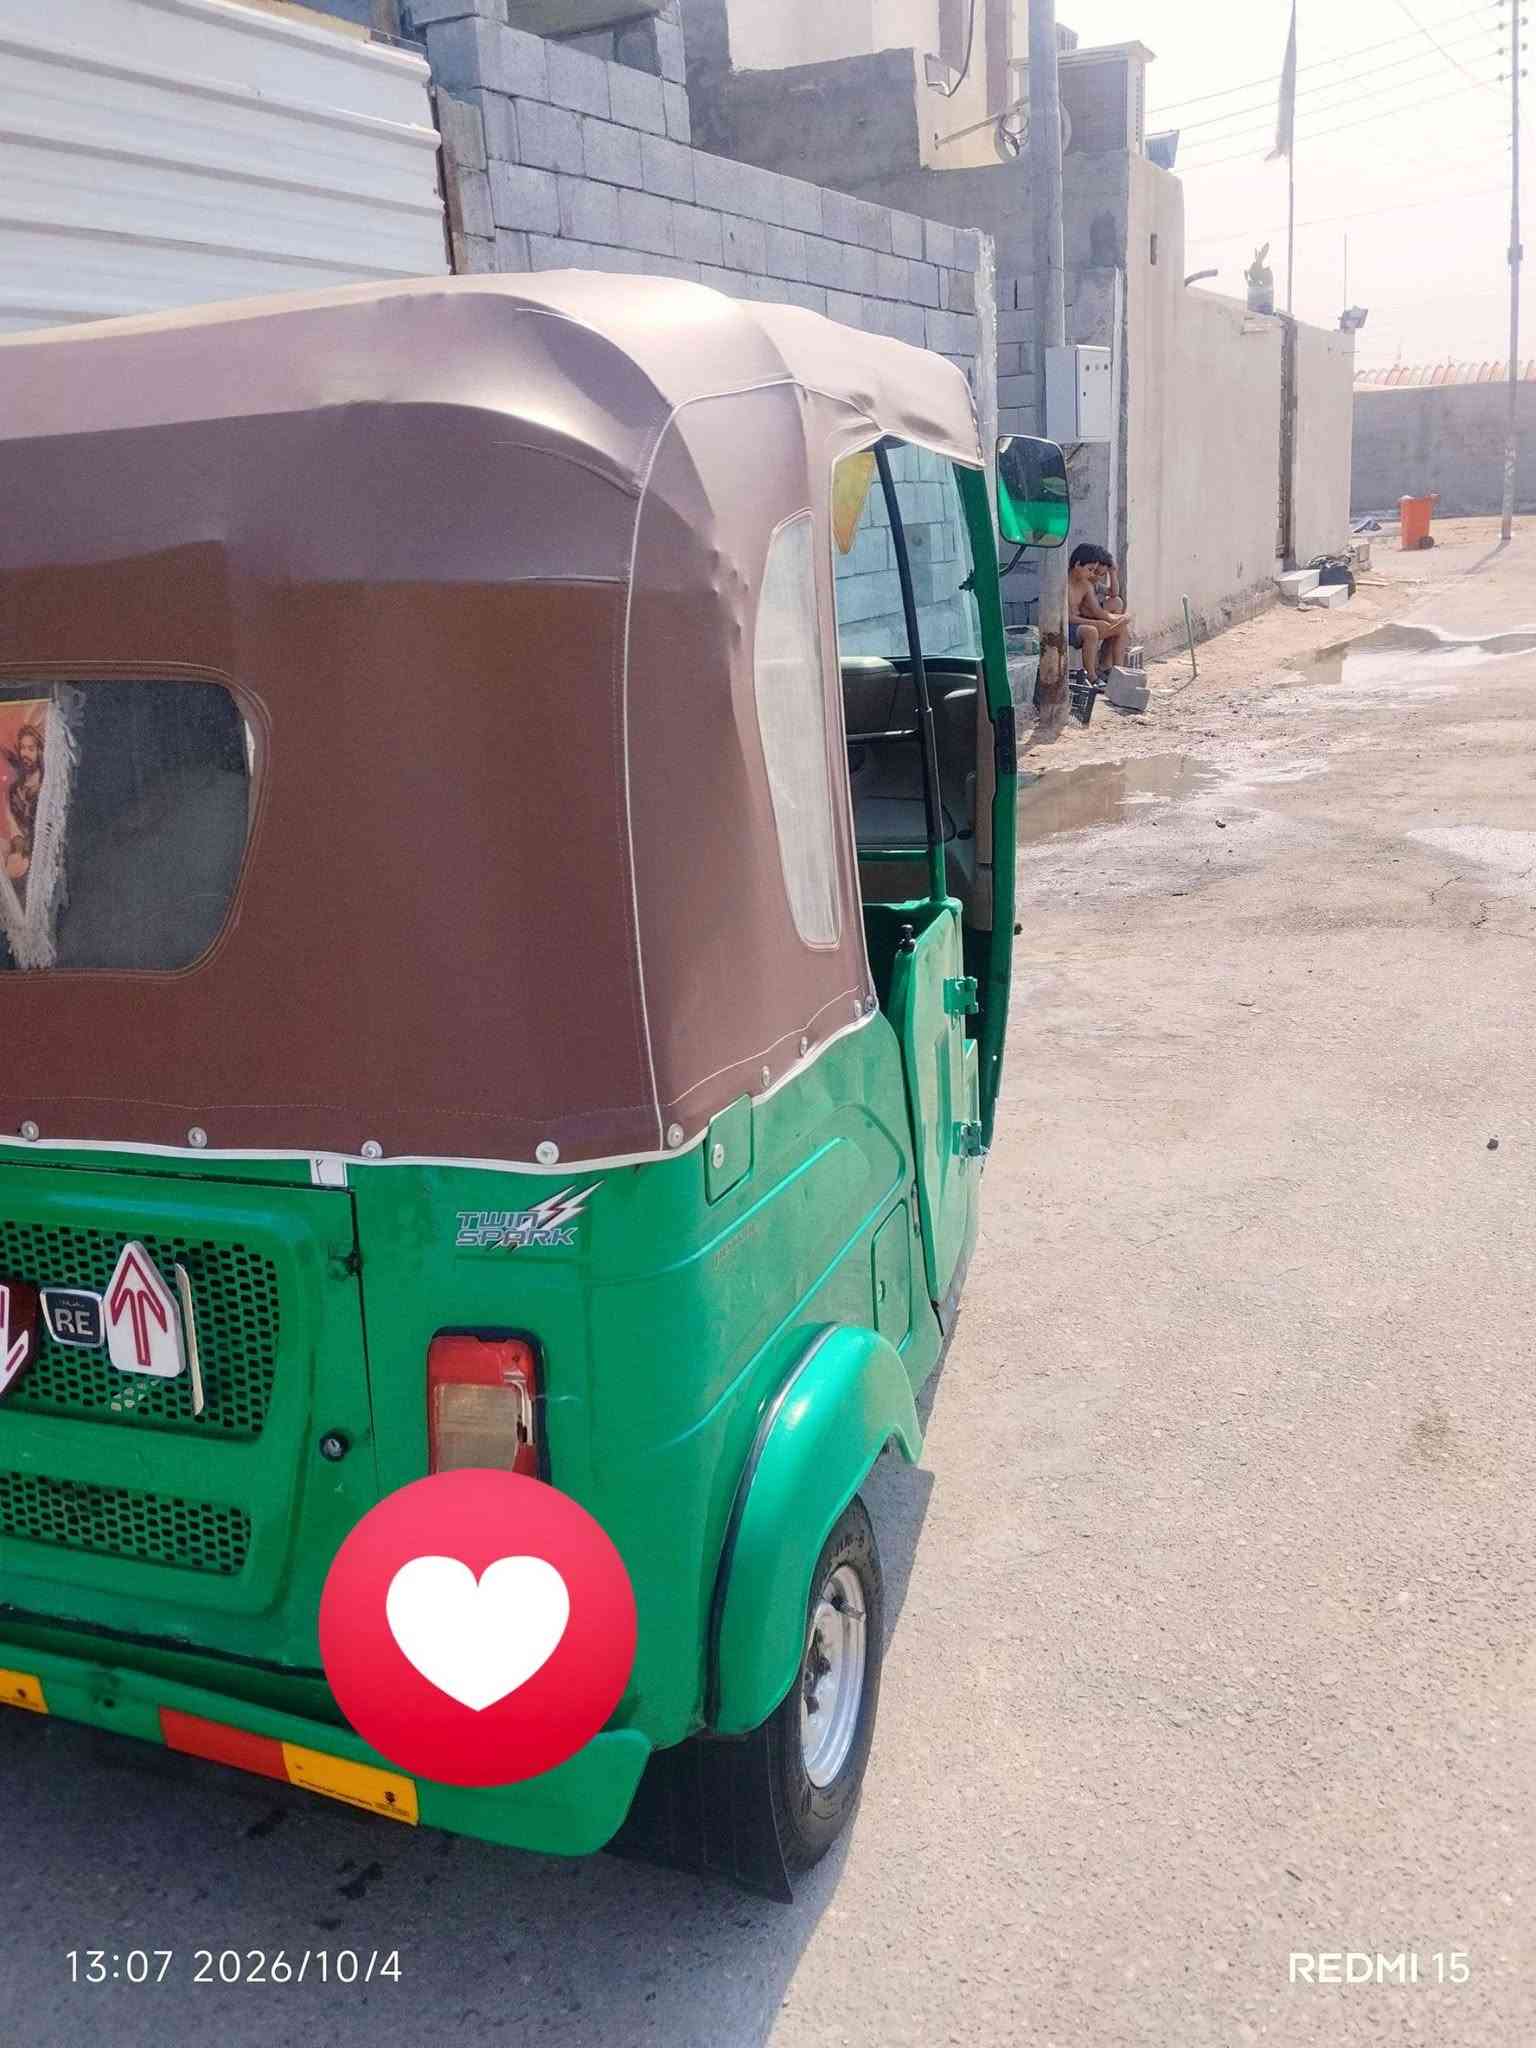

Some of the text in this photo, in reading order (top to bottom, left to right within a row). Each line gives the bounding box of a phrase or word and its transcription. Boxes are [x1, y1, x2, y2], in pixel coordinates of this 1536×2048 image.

[456, 1211, 539, 1229] TWIN
[456, 1227, 578, 1247] SPARK
[54, 1308, 94, 1336] RE
